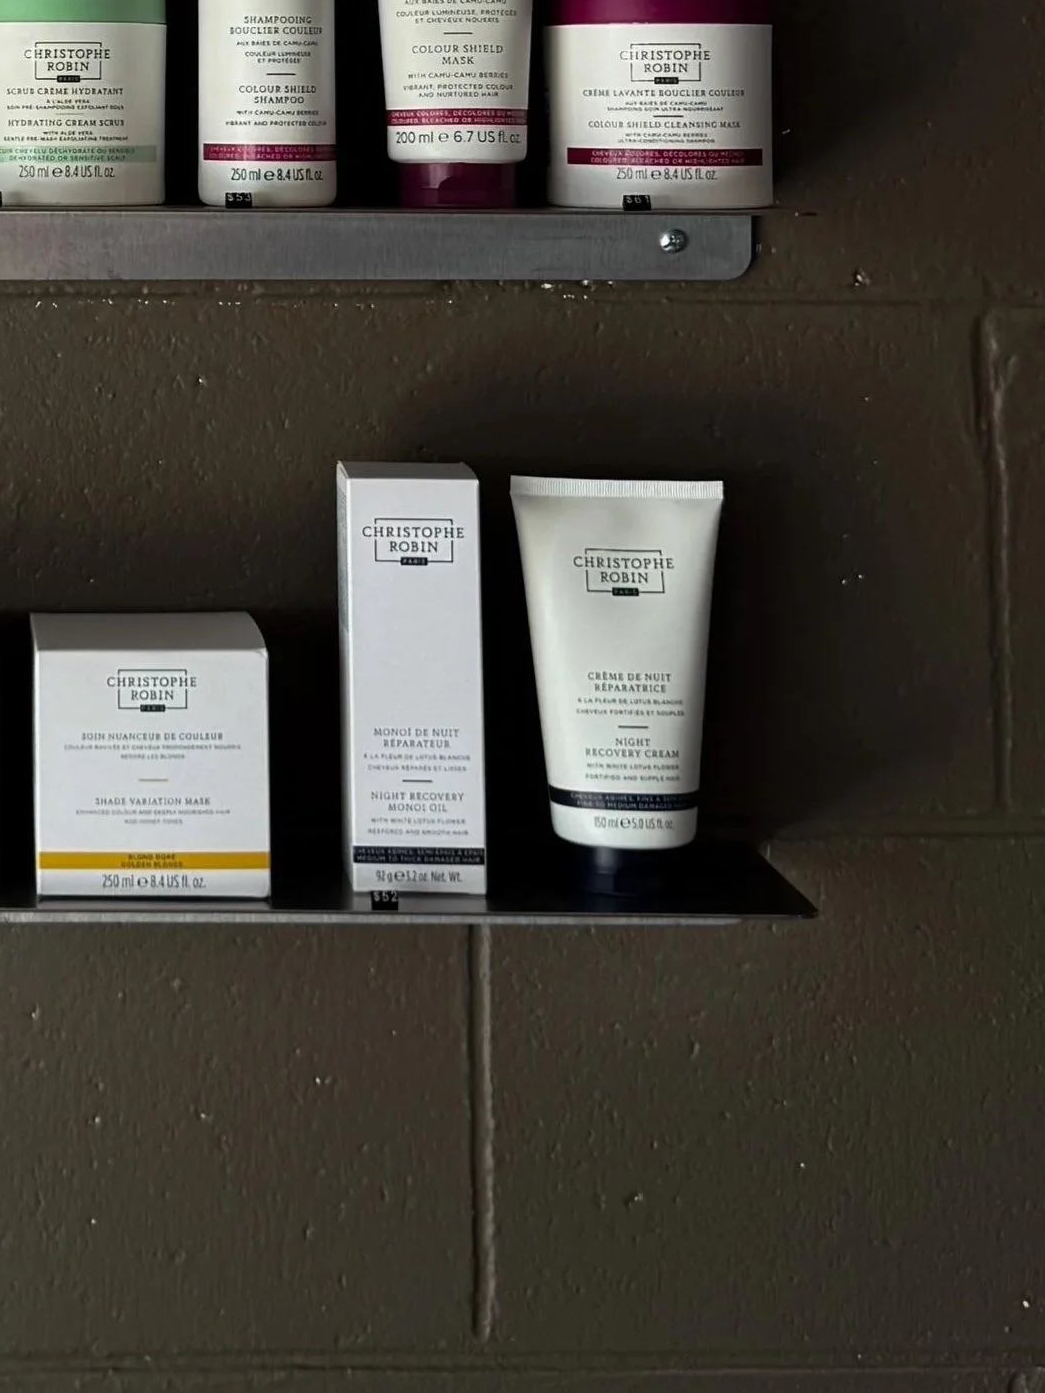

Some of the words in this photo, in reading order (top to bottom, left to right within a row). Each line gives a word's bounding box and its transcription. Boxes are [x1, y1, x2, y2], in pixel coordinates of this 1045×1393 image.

[412, 44, 459, 54] COLOUR
[463, 45, 503, 53] SHIELD
[24, 49, 110, 60] CHRISTOPHE
[620, 50, 711, 60] CHRISTOPHE
[442, 56, 474, 65] MASK
[47, 62, 90, 71] ROBIN
[644, 63, 688, 73] ROBIN
[396, 131, 416, 144] 200
[419, 131, 433, 143] ml
[454, 130, 474, 142] 6.7
[477, 131, 495, 143] US
[362, 525, 465, 540] CHRISTOPHE
[389, 540, 439, 553] ROBIN
[573, 556, 675, 570] CHRISTOPHE
[600, 571, 650, 584] ROBIN
[588, 671, 624, 681] CRÈME
[627, 673, 641, 681] DE
[645, 673, 671, 682] NUIT
[106, 676, 197, 688] CHRISTOPHE
[131, 690, 174, 701] ROBIN
[415, 728, 428, 737] DE
[432, 728, 459, 738] NUIT
[615, 737, 650, 747] NIGHT
[586, 748, 641, 758] RECOVERY
[644, 749, 679, 758] CREAM
[371, 791, 406, 800] NIGHT
[410, 792, 464, 801] RECOVERY
[429, 803, 447, 812] OIL
